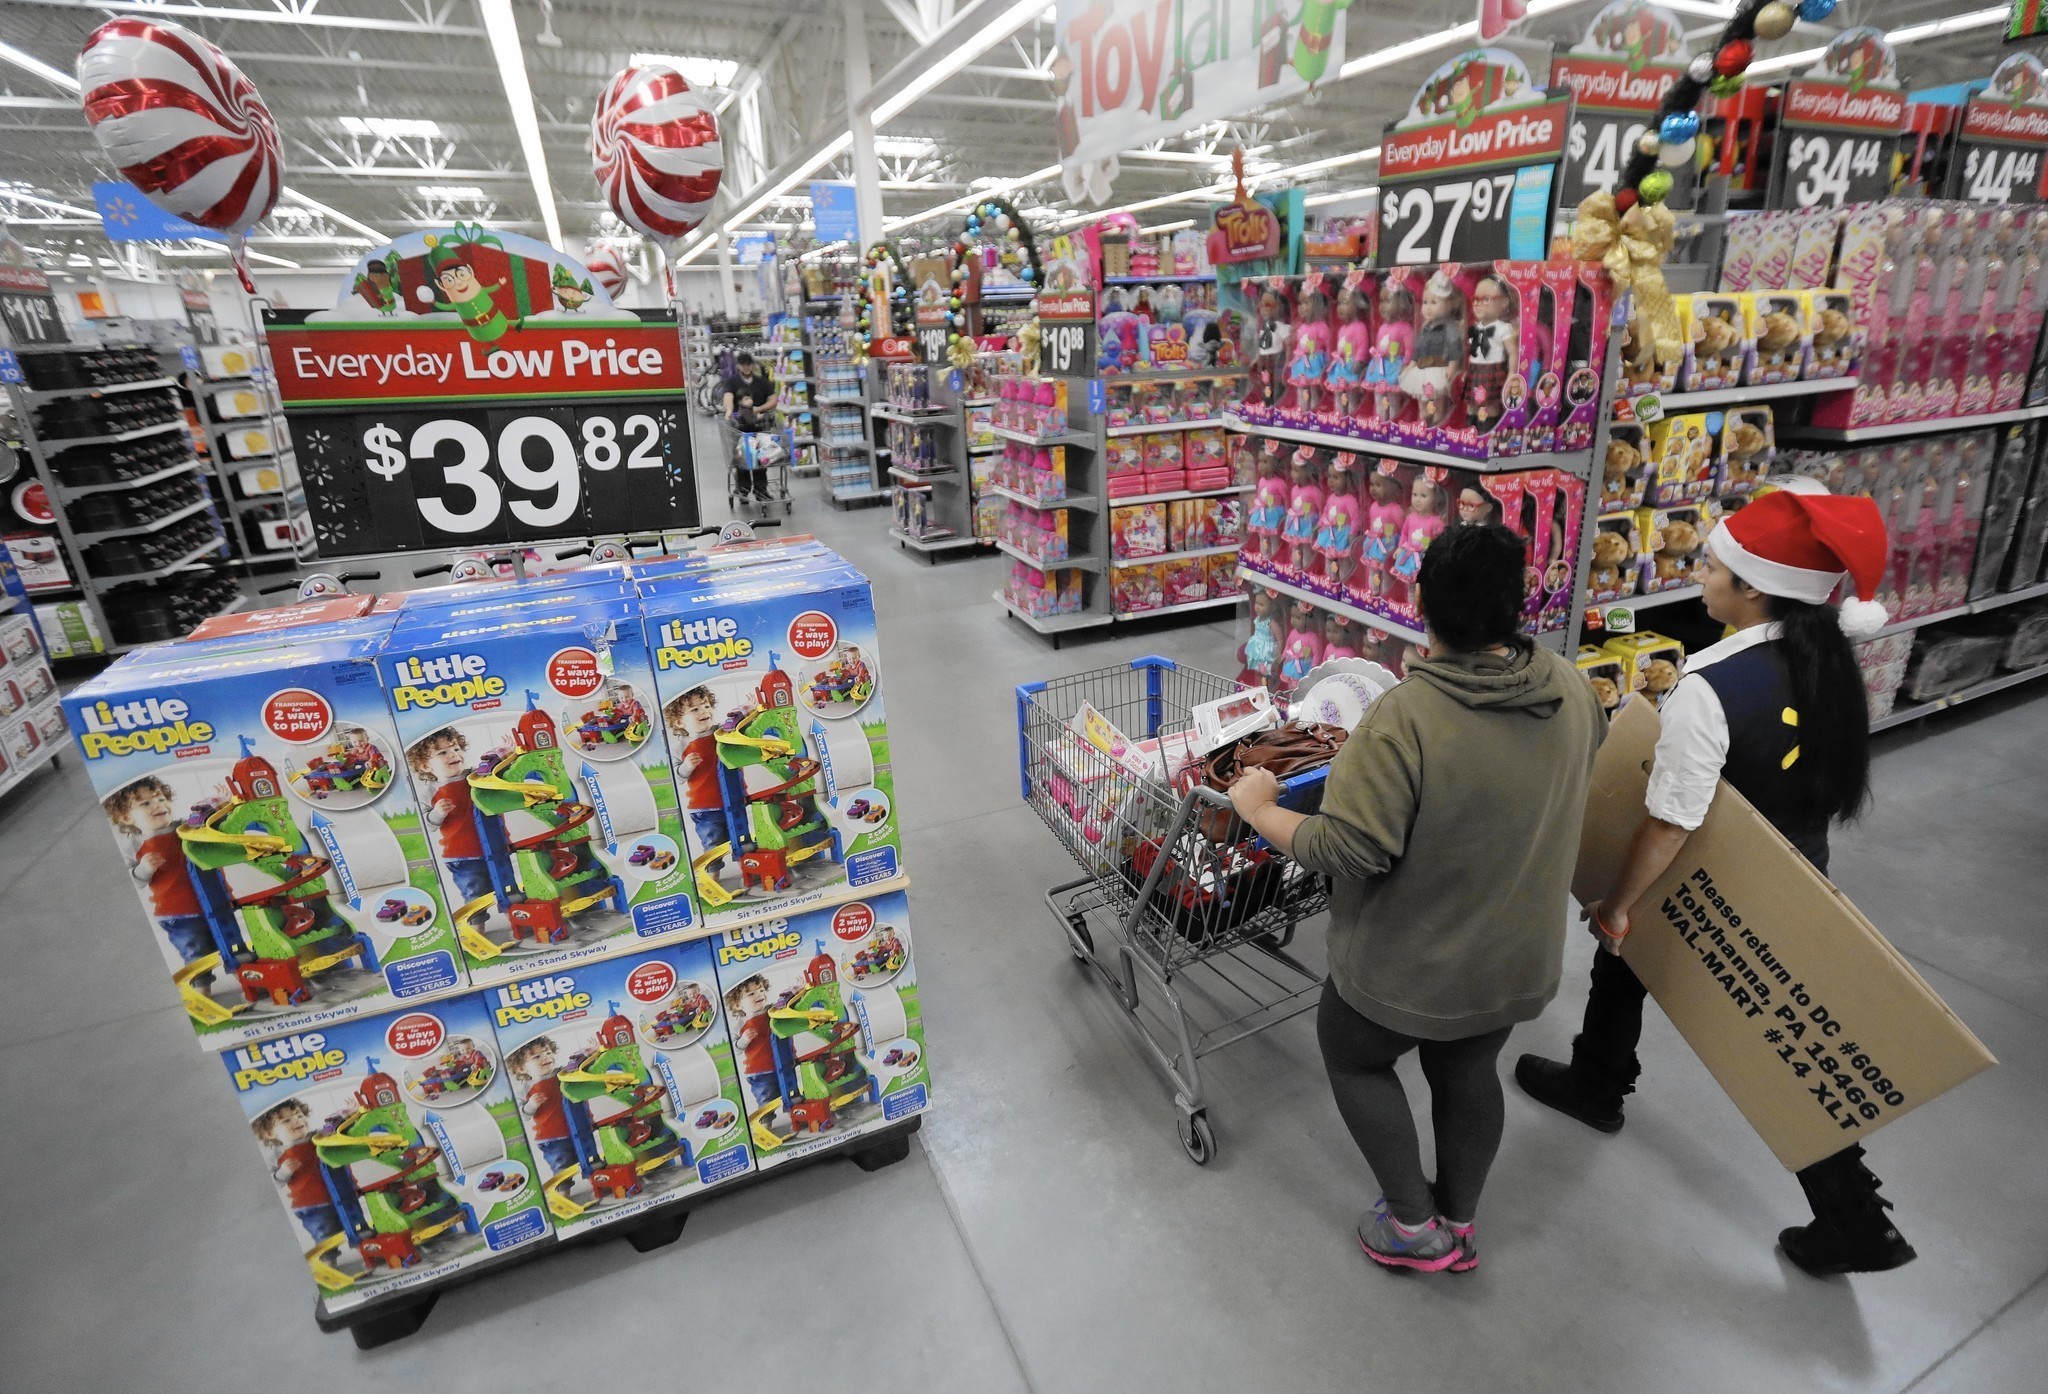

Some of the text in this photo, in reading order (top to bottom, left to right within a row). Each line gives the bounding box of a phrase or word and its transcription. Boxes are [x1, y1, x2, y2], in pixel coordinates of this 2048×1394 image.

[1557, 67, 1620, 100] Everyday
[1618, 71, 1657, 101] Low
[1838, 93, 1867, 119] Low
[1385, 115, 1553, 165] Everyday Low Price
[292, 338, 663, 385] Everyday Low Price
[1448, 430, 1460, 443] my
[660, 617, 738, 648] Little
[796, 629, 829, 640] 2 ways
[807, 639, 830, 649] play!
[657, 637, 752, 670] People
[394, 653, 487, 687] Little
[555, 677, 597, 687] to play!
[556, 667, 595, 678] 2 ways
[393, 674, 505, 711] People
[80, 698, 189, 734] Little
[273, 710, 321, 722] 2 ways
[273, 720, 323, 732] to play!
[80, 719, 214, 759] People
[817, 733, 826, 754] Over
[588, 776, 599, 798] Over
[600, 810, 610, 829] feet
[321, 826, 336, 854] Over
[338, 861, 352, 882] feet
[855, 850, 886, 863] Discover:
[870, 870, 892, 882] YEARS
[642, 898, 678, 913] Discover:
[737, 910, 751, 920] Sit
[763, 901, 789, 913] Stand
[790, 892, 823, 906] Skyway
[662, 920, 688, 932] YEARS
[722, 918, 789, 947] Little
[837, 923, 868, 935] to play!
[838, 917, 868, 927] 2 ways
[508, 964, 525, 974] Sit
[537, 953, 568, 967] Stand
[569, 943, 608, 960] Skyway
[719, 932, 801, 966] People
[396, 957, 439, 972] Discover:
[422, 979, 451, 991] YEARS
[497, 976, 575, 1008] Little
[633, 983, 670, 995] to play!
[634, 977, 668, 988] 2 ways
[1690, 867, 1905, 1107] Please return to DC #6080
[495, 992, 591, 1028] People
[1660, 896, 1861, 1131] WAL-MART #14 XLT
[1675, 882, 1881, 1121] Tobyhanna, PA 18466
[243, 1028, 261, 1039] Sit
[277, 1015, 313, 1030] Stand
[314, 1005, 359, 1021] Skyway
[395, 1029, 435, 1042] 2 ways
[235, 1033, 327, 1070] Little
[395, 1037, 437, 1050] to play!
[234, 1048, 346, 1091] People
[786, 1128, 862, 1159] Sit Stand Skyway
[590, 1193, 676, 1228] Sit Stand Skyway
